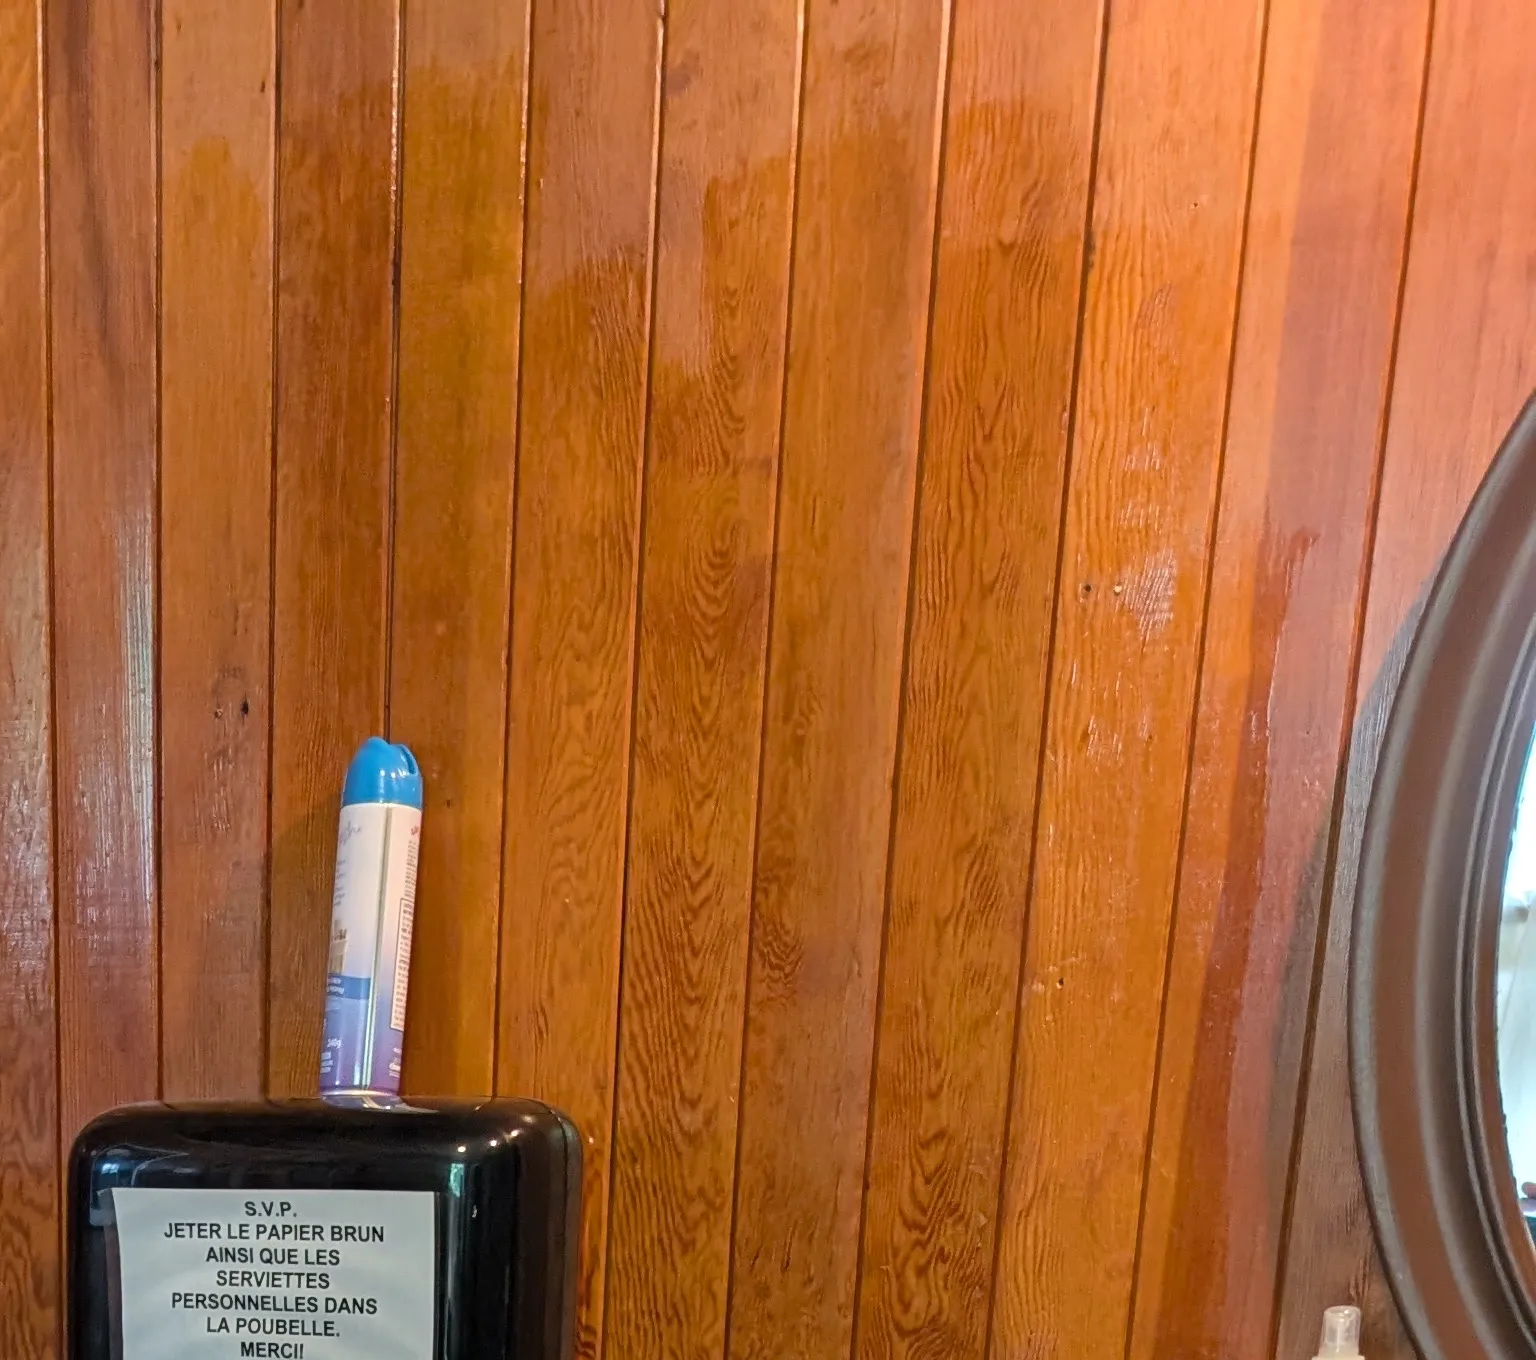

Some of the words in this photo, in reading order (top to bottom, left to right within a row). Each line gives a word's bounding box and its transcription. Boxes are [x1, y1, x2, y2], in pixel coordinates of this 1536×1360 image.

[244, 1200, 298, 1217] S.V.P.
[164, 1222, 222, 1239] JETER
[227, 1223, 250, 1240] LE
[255, 1224, 324, 1241] PAPIER
[330, 1225, 384, 1242] BRUN
[205, 1246, 254, 1263] AINSI
[259, 1247, 299, 1265] QUE
[304, 1249, 340, 1266] LES
[216, 1270, 330, 1289] SERVIETTES
[171, 1292, 319, 1313] PERSONNELLES
[324, 1296, 378, 1315] DANS
[206, 1317, 230, 1334] LA
[235, 1317, 340, 1337] POUBELLE.
